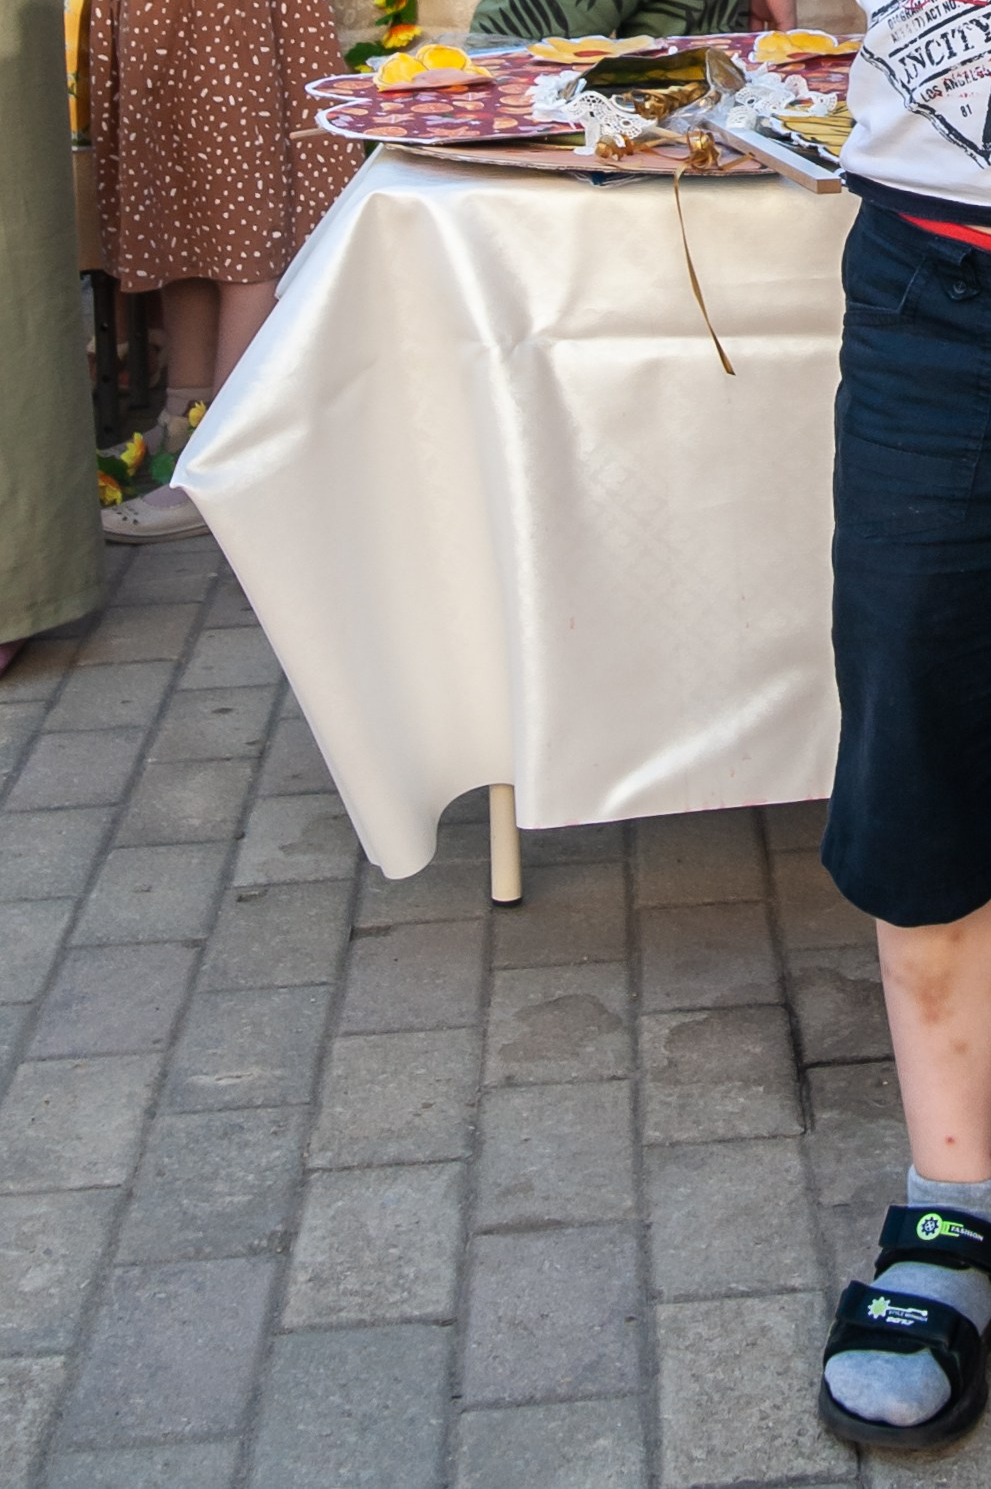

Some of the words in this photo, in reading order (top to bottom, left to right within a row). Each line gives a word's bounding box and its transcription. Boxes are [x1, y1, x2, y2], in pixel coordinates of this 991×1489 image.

[920, 86, 943, 103] LOS
[960, 104, 973, 118] 81
[950, 1225, 985, 1242] FASHION
